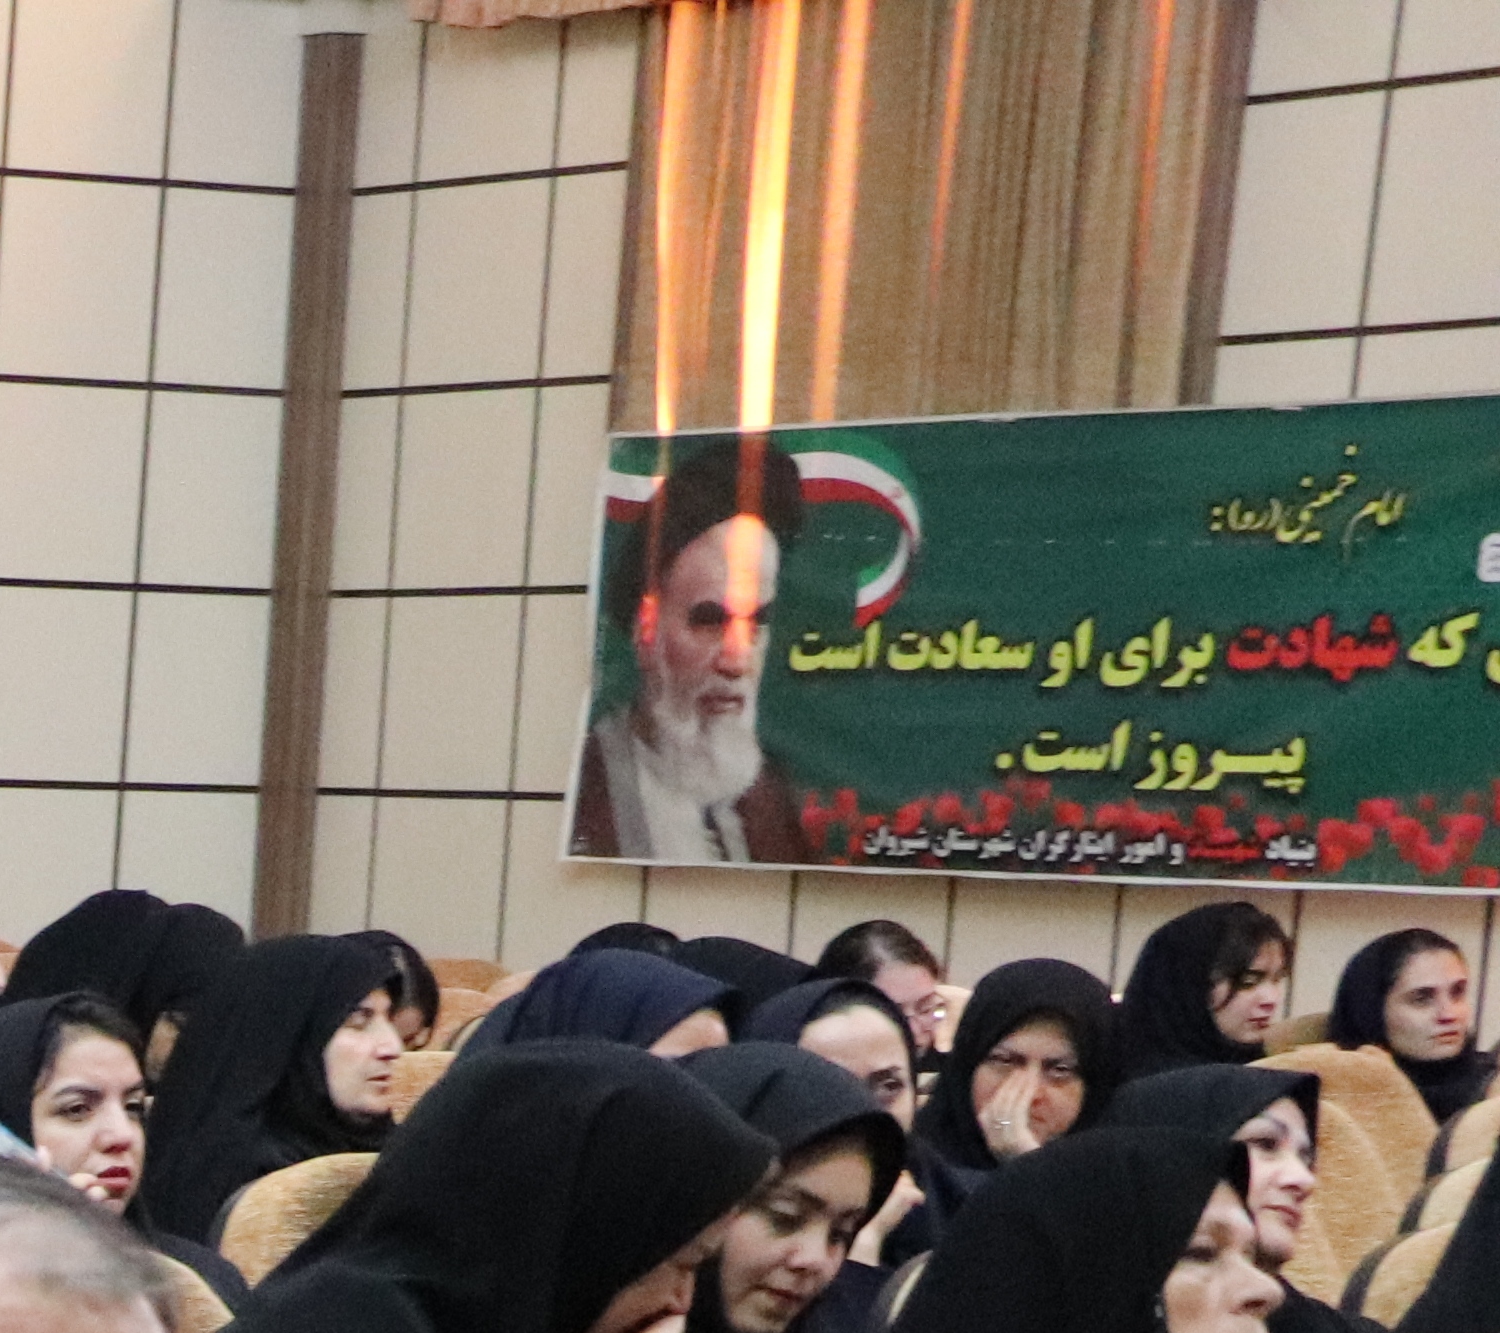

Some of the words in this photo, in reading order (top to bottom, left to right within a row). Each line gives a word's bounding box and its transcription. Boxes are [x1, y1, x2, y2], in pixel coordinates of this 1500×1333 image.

[789, 618, 883, 672] است
[886, 618, 1035, 672] سعادت
[1039, 616, 1095, 688] او
[1100, 615, 1215, 688] برای
[1225, 613, 1400, 684] شهادت
[1406, 611, 1481, 668] که
[1133, 730, 1308, 795] پیروز
[862, 825, 931, 857] شیروان
[931, 825, 1017, 859] شهرستان
[1018, 828, 1117, 863] ایثارگران
[1119, 831, 1168, 865] امور
[1168, 842, 1186, 866] و
[1263, 833, 1318, 869] بنیاد
